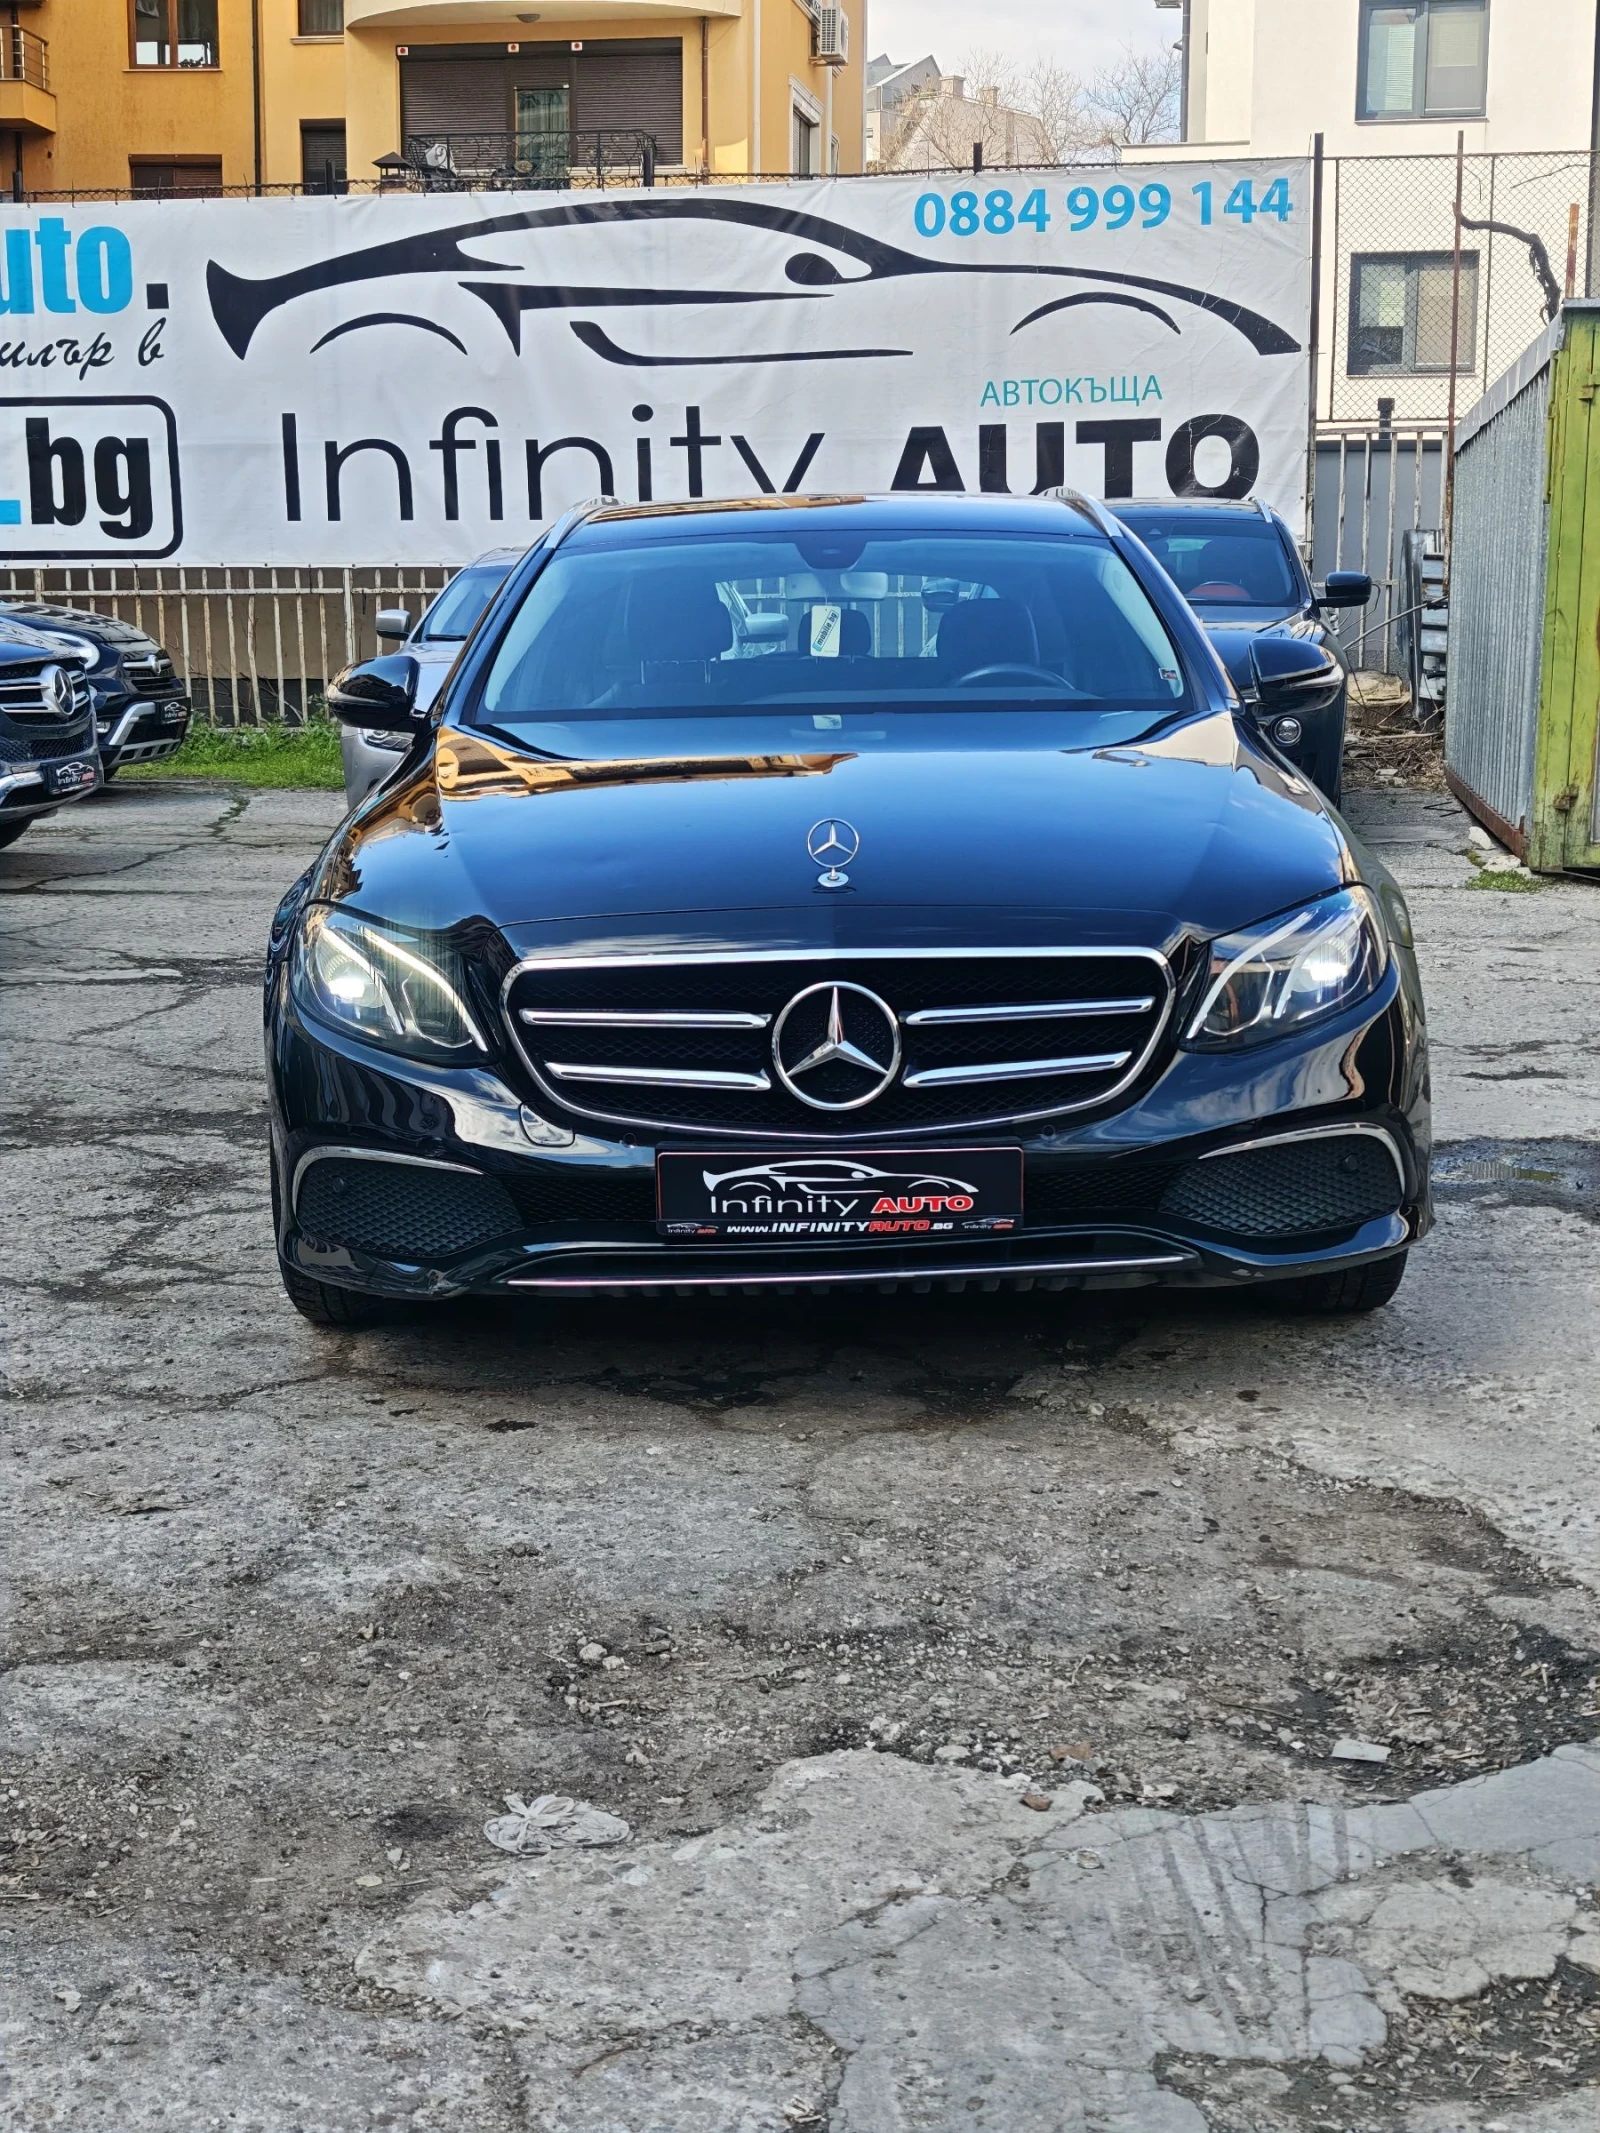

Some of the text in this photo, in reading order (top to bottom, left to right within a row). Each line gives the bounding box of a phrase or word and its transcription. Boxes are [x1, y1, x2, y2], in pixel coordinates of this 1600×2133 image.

[914, 177, 1294, 238] 0884 999 144
[137, 316, 167, 366] в
[980, 374, 1163, 407] АВТОКЪЩА
[281, 403, 1260, 521] Infinity AUTO
[710, 1195, 974, 1216] Infinity AUTO
[726, 1219, 954, 1233] www.INFINITYAUTO.BG
